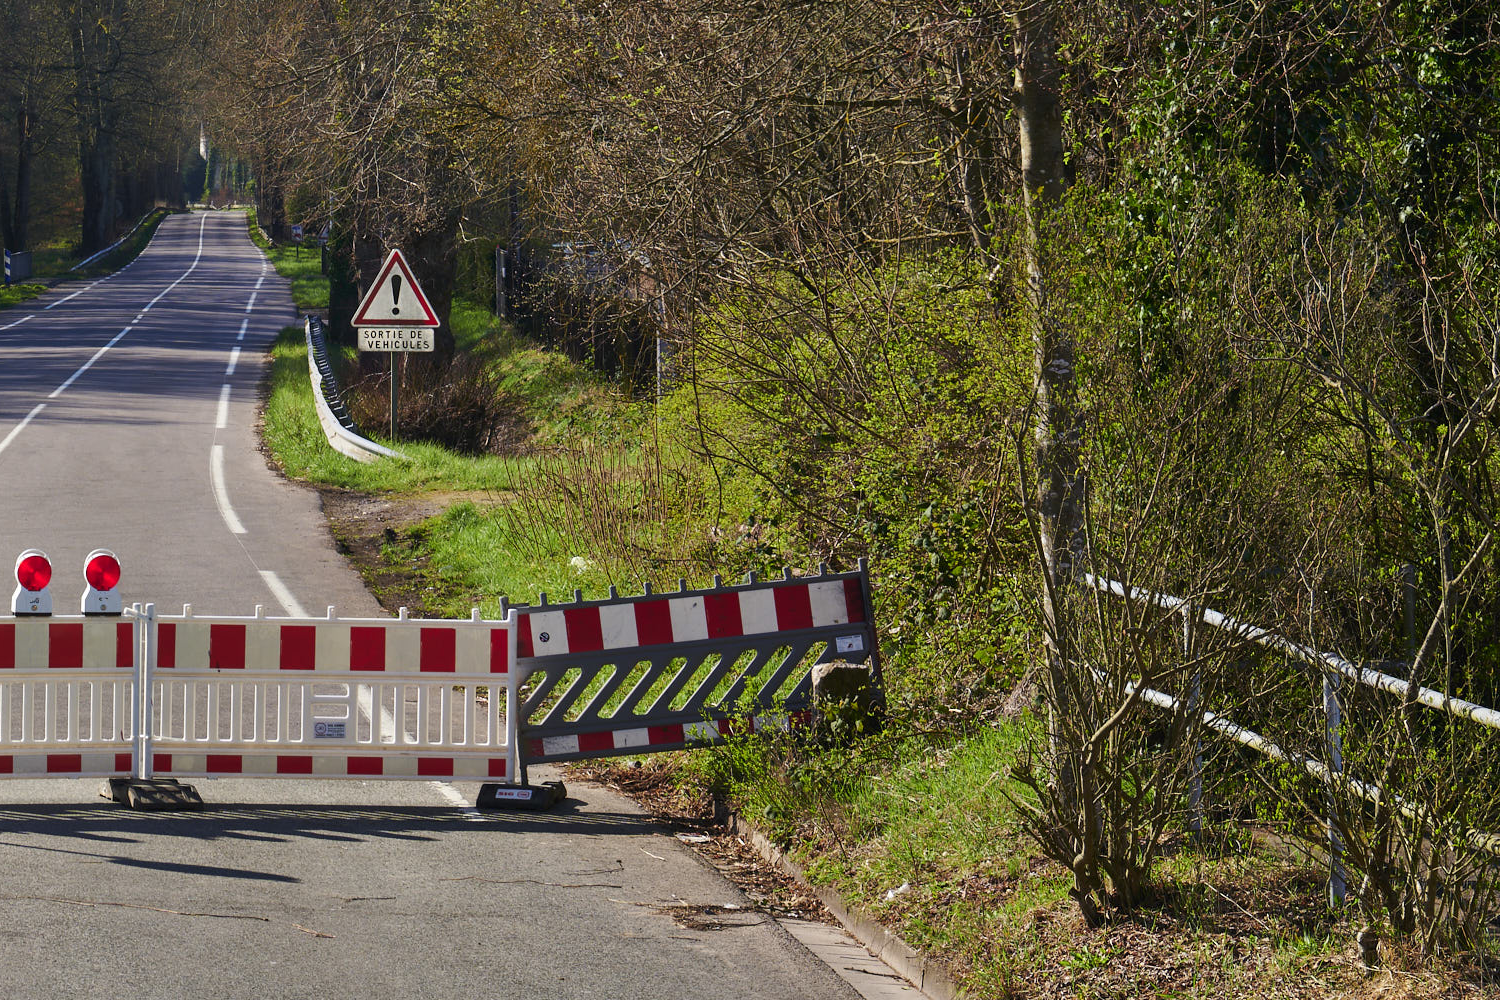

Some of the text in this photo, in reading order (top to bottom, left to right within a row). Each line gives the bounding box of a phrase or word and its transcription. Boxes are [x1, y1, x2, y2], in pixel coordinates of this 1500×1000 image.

[364, 330, 423, 339] SORTIE DE
[367, 340, 430, 349] VEHICULES
